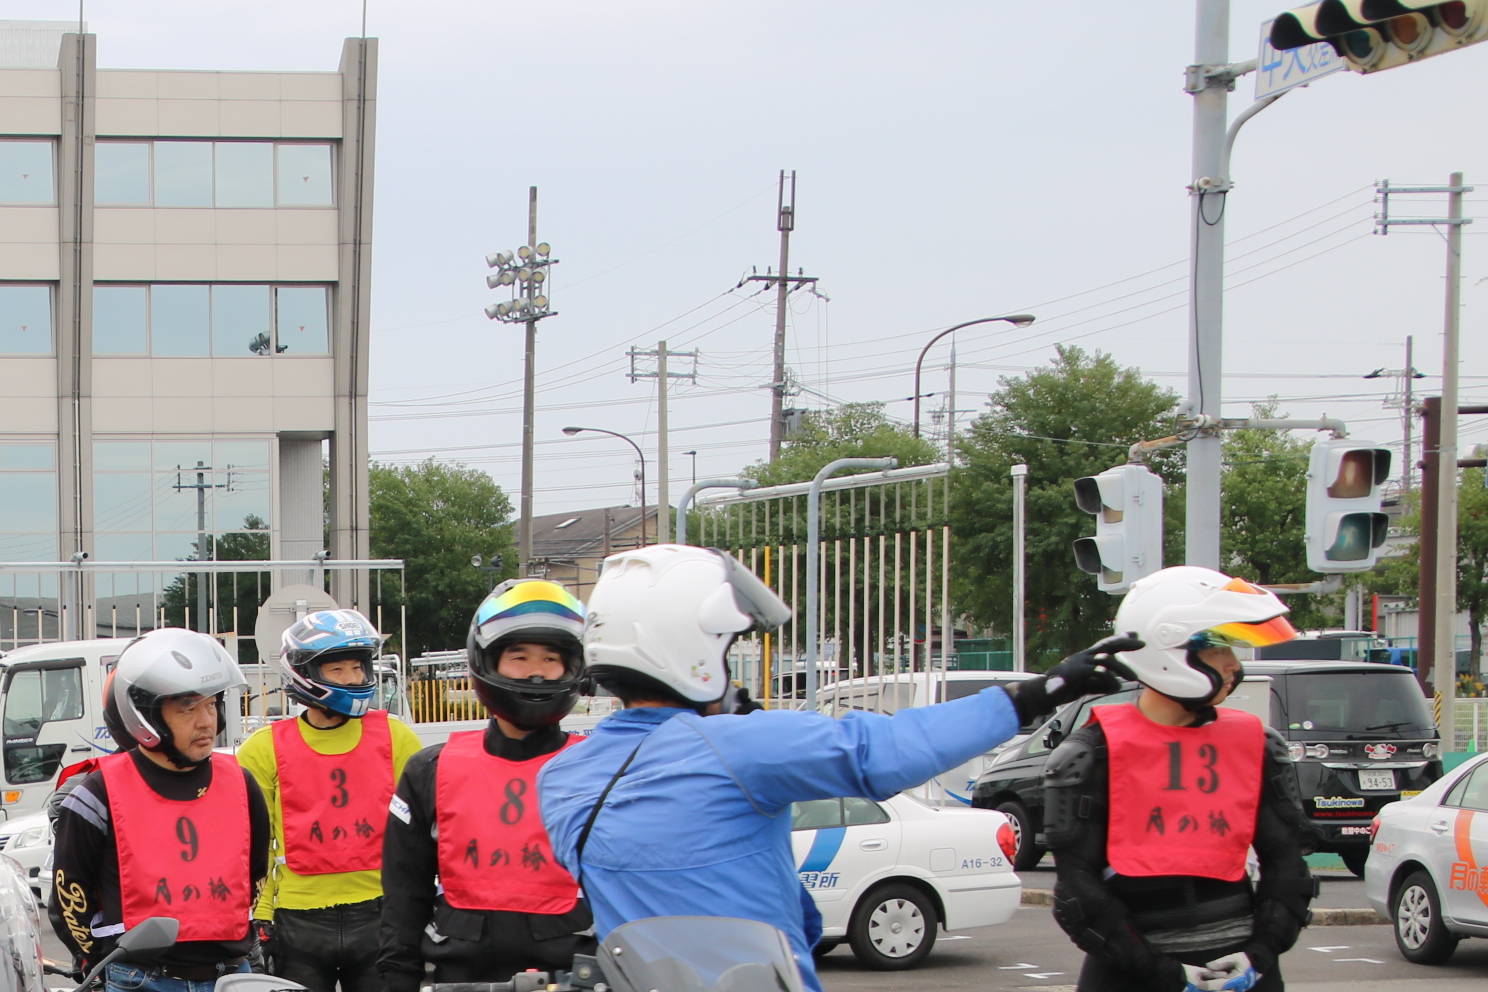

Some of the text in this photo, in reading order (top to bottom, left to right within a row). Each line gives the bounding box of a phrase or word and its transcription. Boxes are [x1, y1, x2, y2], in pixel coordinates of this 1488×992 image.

[1161, 741, 1220, 794] 13
[330, 768, 349, 808] 3
[499, 778, 527, 826] 8
[1315, 797, 1364, 807] Tsukinowa
[309, 818, 376, 845] 月の輪
[1145, 805, 1231, 837] 月の輪
[176, 816, 198, 862] 9
[463, 838, 548, 872] 月の輪
[962, 857, 1002, 869] A16-32
[155, 876, 232, 906] 月の輪
[55, 869, 94, 954] Bates
